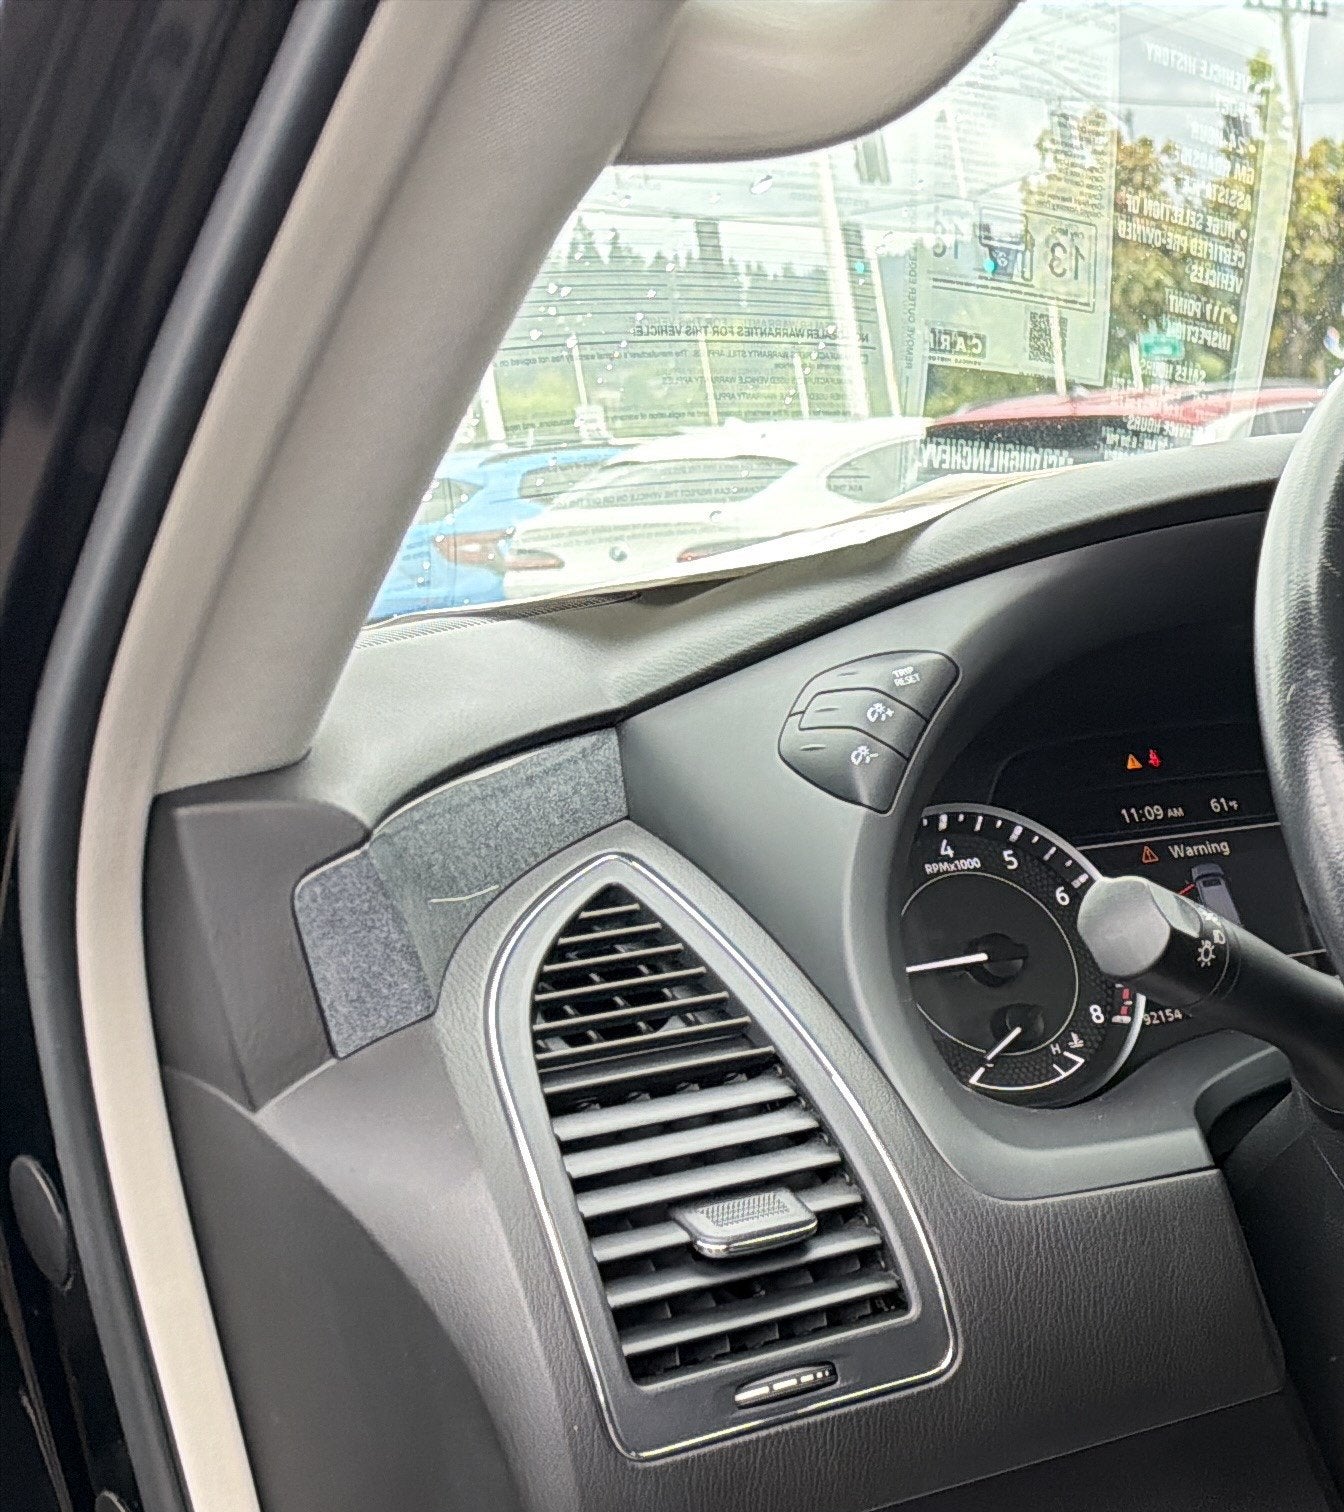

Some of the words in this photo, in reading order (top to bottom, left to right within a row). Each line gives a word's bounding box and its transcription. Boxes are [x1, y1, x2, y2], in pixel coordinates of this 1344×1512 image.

[892, 665, 914, 678] TRIP
[893, 673, 920, 687] RESET
[1120, 804, 1164, 824] 11:09
[1167, 806, 1185, 819] AM
[940, 838, 956, 859] 4
[1168, 840, 1231, 860] Warning
[923, 856, 983, 876] RPMx1000
[1002, 849, 1020, 870] 5
[1054, 886, 1071, 907] 6
[1089, 1004, 1106, 1025] 8
[1142, 1007, 1184, 1027] 92154
[1051, 1042, 1062, 1056] H
